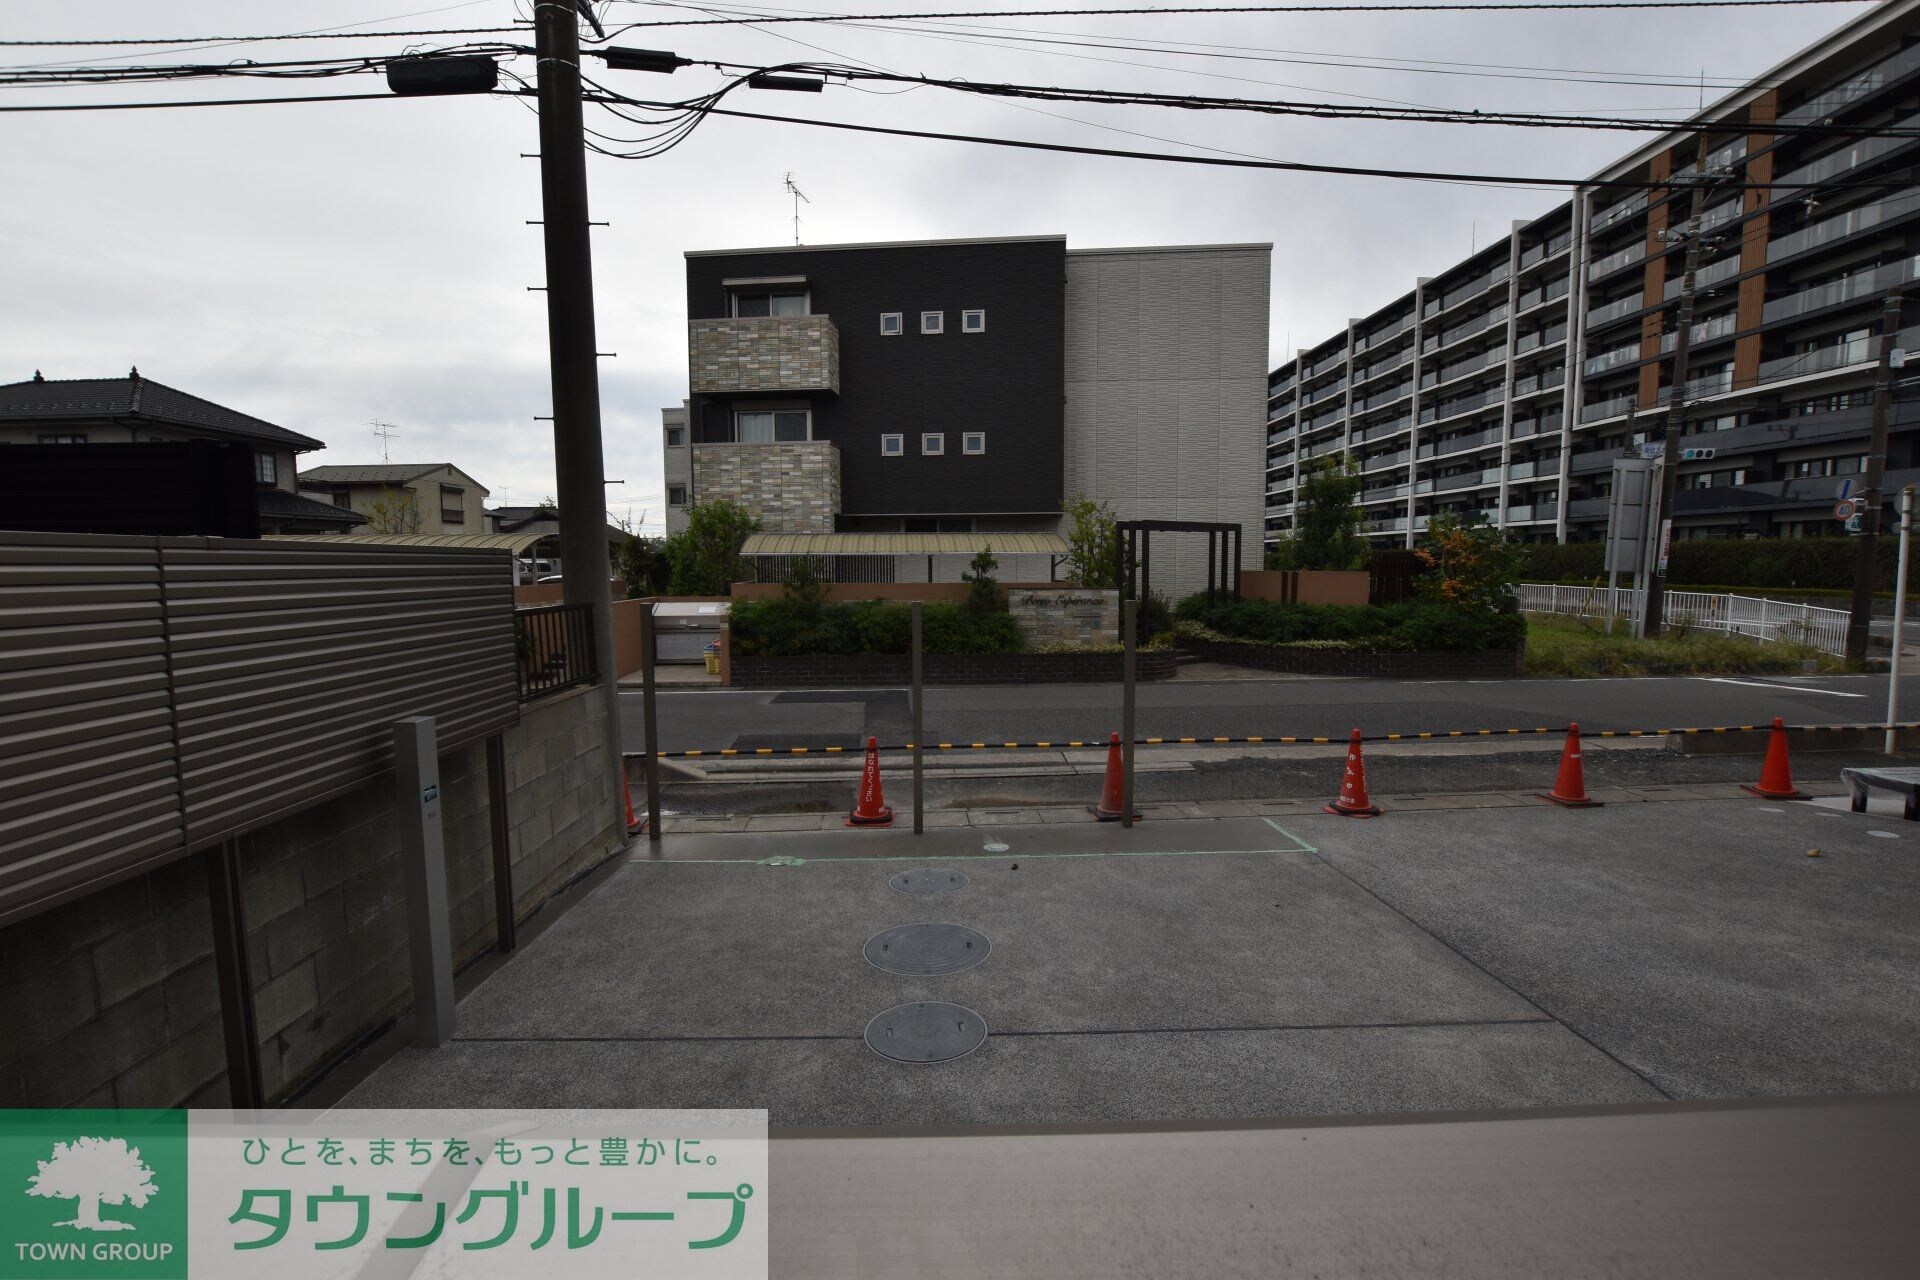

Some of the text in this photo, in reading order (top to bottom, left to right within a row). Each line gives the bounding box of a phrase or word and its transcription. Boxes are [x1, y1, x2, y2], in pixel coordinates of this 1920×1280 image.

[1839, 505, 1849, 514] 40
[865, 752, 874, 801] はなれてください
